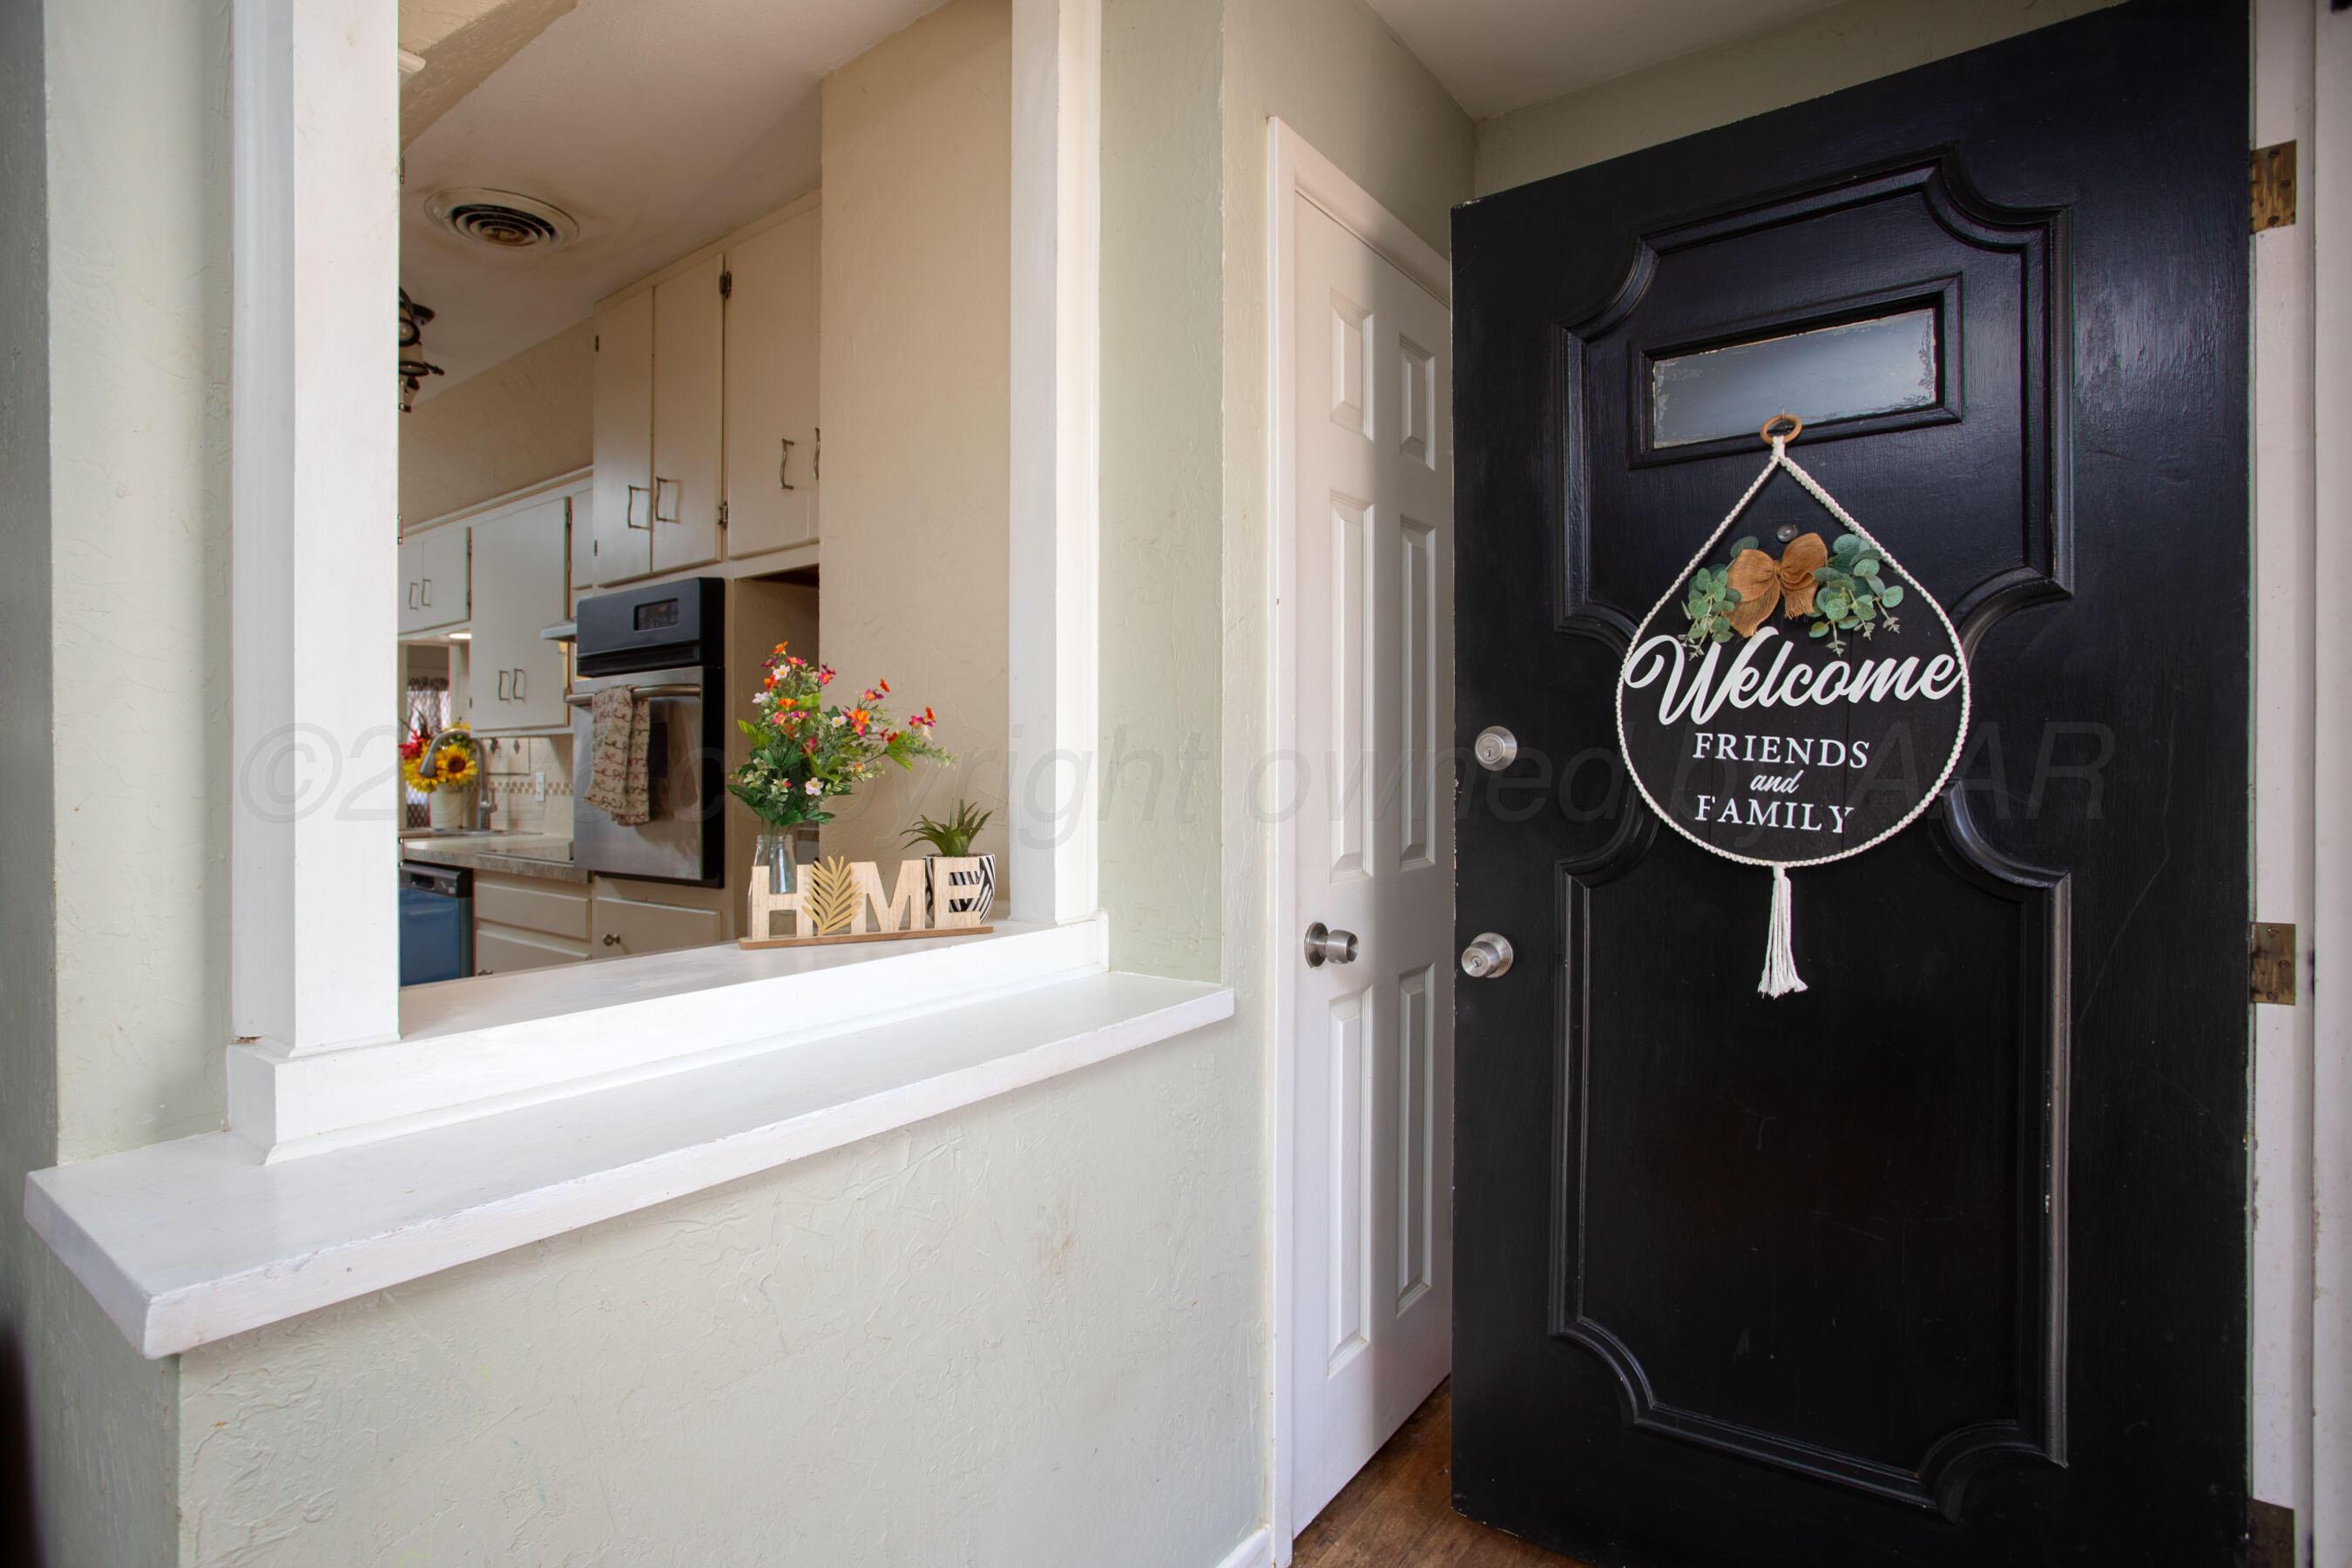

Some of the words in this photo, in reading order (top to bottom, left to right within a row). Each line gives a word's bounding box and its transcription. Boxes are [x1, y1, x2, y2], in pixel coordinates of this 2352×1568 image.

[1624, 625, 1963, 726] Welcome
[1692, 732, 1870, 769] FRIENDS
[1749, 769, 1805, 794] and
[1694, 794, 1855, 834] FAMILY
[751, 855, 982, 941] HME
